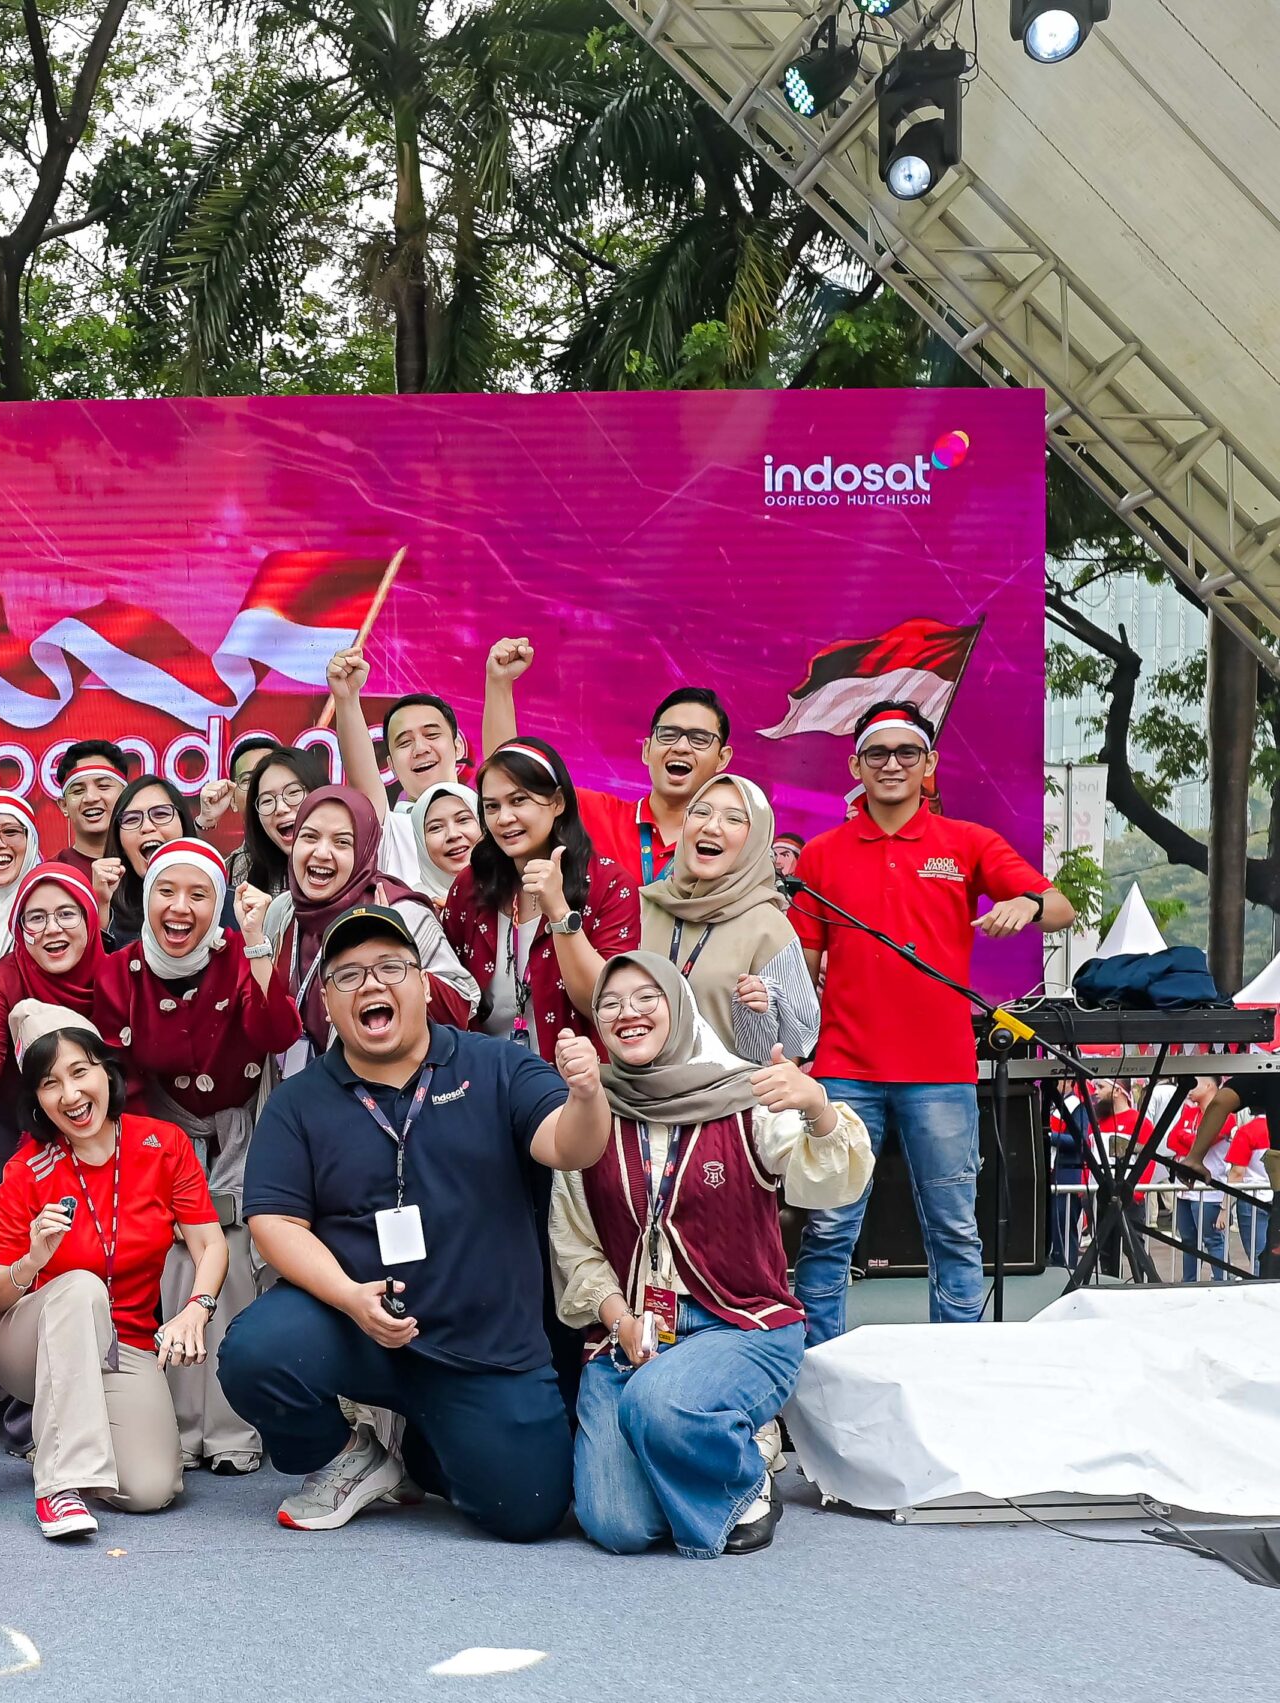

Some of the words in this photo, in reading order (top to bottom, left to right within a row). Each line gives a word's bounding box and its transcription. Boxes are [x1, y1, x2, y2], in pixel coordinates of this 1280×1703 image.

[764, 455, 931, 492] indosat
[764, 494, 840, 506] OOREDOO
[847, 493, 931, 506] HUTCHISON
[923, 862, 959, 874] WARDEN
[927, 857, 955, 867] FLOOR
